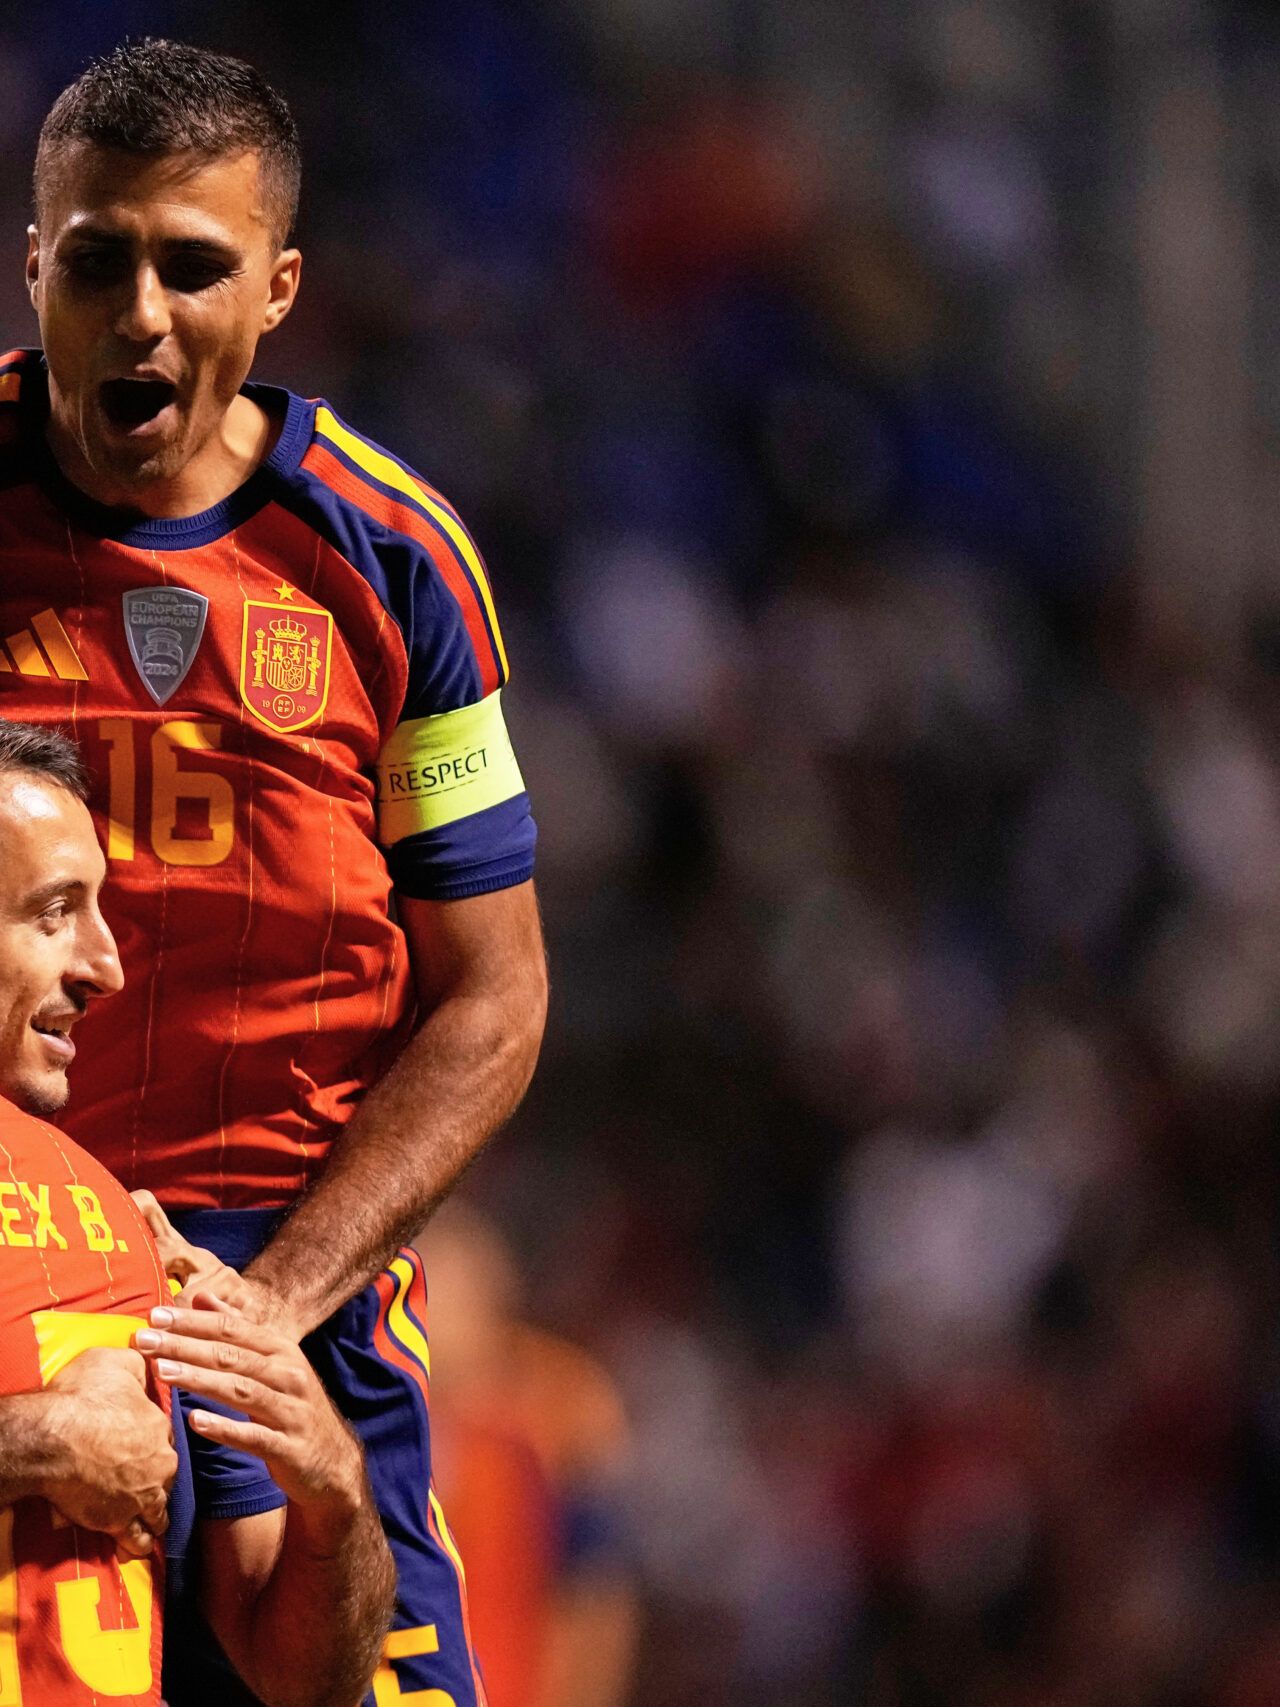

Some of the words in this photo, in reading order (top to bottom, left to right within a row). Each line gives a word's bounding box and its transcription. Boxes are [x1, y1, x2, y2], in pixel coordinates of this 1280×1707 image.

[151, 592, 178, 603] UEFA
[131, 601, 199, 617] EUROPEAN
[131, 613, 197, 628] CHAMPIONS
[144, 662, 179, 676] 2024
[389, 748, 488, 793] RESPECT
[98, 719, 234, 866] 16
[64, 1184, 129, 1253] B.
